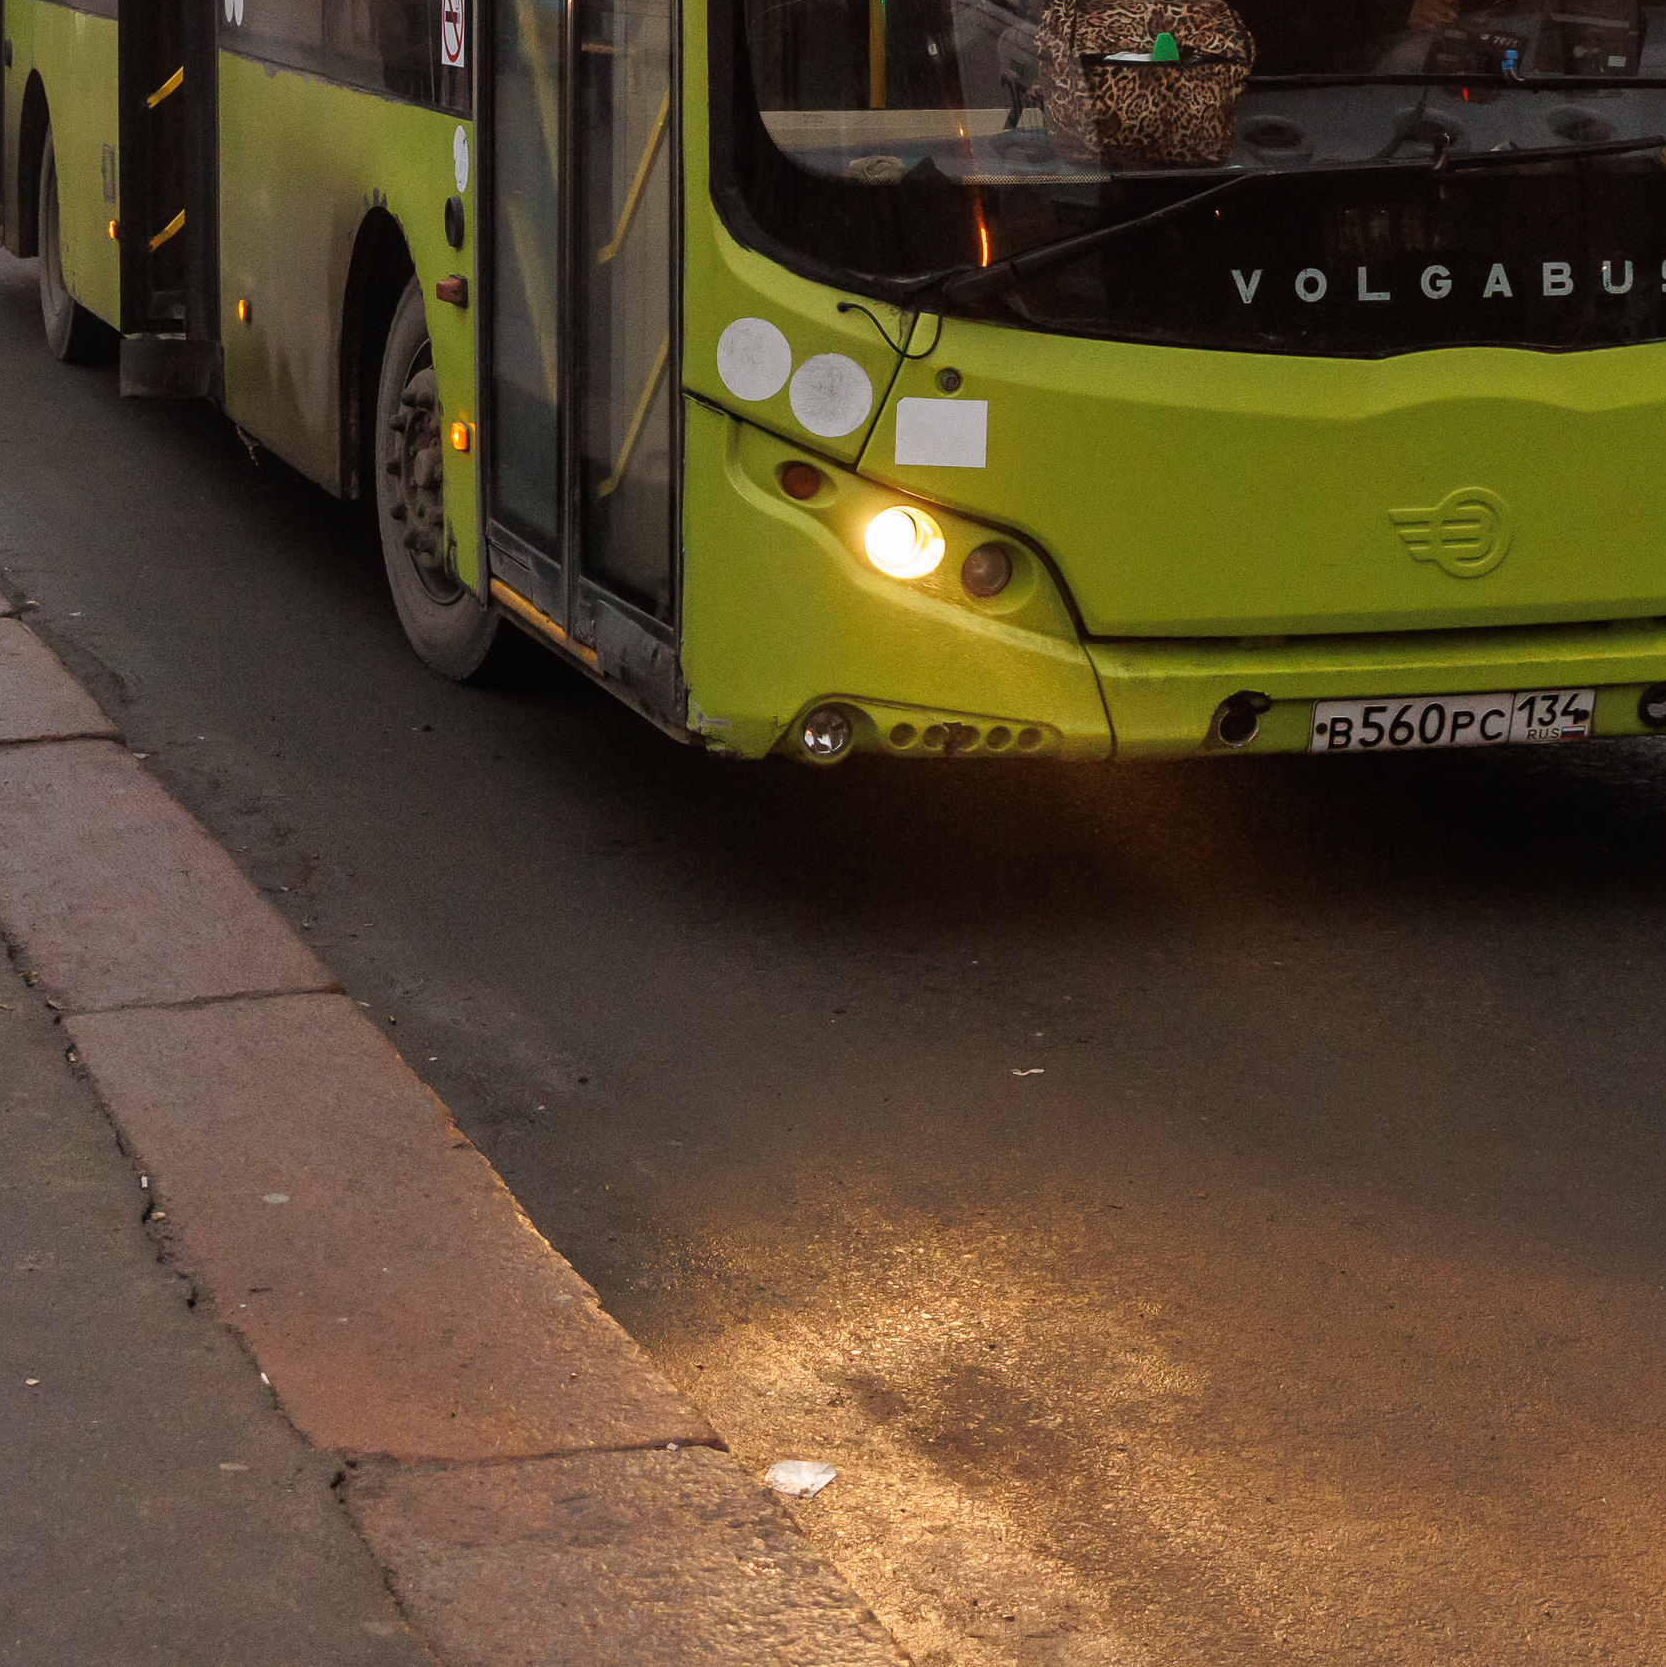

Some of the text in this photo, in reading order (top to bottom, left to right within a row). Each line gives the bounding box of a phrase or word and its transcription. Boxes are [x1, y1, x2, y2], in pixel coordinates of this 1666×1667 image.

[1328, 692, 1581, 749] В560РС 134
[1527, 727, 1560, 740] RUS
